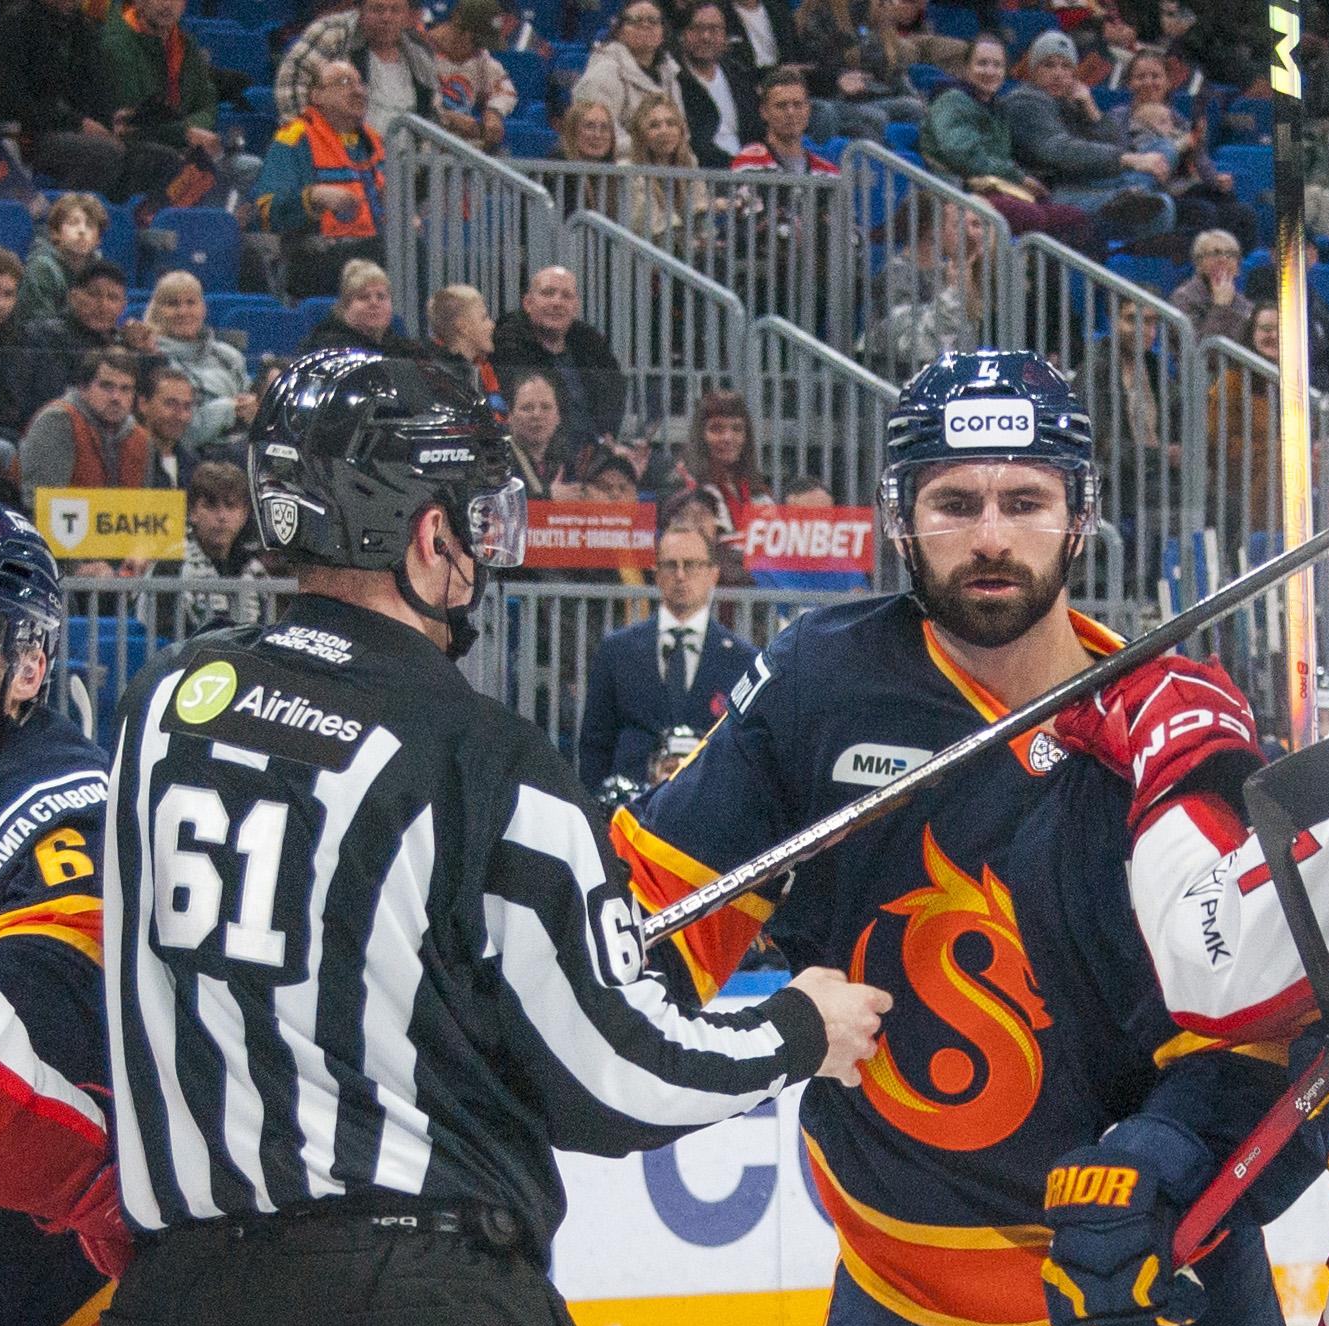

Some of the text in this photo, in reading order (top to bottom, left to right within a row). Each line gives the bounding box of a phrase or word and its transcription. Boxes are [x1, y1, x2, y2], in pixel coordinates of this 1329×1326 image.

[96, 512, 170, 536] БАНК
[746, 518, 872, 559] FONBET
[288, 626, 353, 651] SEASON
[181, 675, 363, 742] S7 Airlines
[852, 754, 908, 776] МИР
[1133, 708, 1252, 789] CCM
[28, 783, 109, 823] СТАВОК
[34, 828, 95, 887] 6
[154, 784, 289, 968] 61
